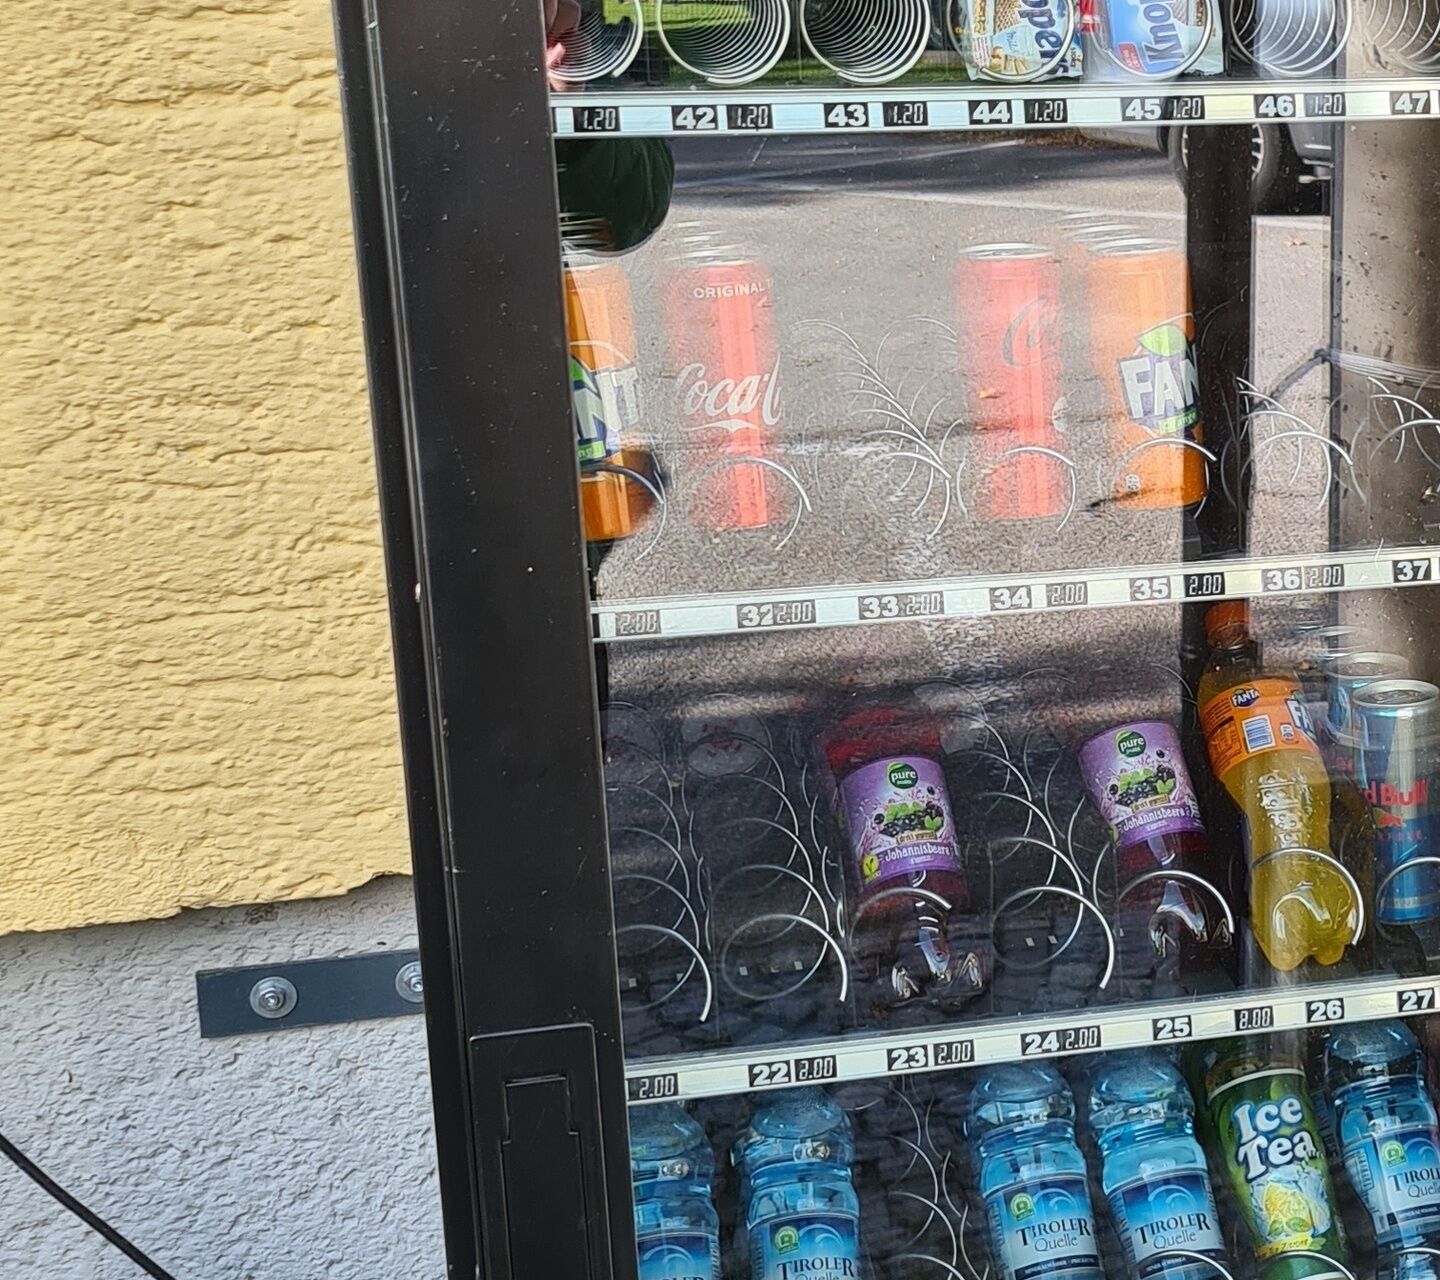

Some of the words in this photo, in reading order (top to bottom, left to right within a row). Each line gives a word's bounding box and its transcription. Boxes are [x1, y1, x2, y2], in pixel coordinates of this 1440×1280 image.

[828, 103, 867, 127] 43
[888, 103, 925, 126] 1.20
[972, 101, 1010, 123] 44
[1031, 100, 1065, 122] 1.20
[1125, 97, 1162, 120] 45
[1172, 96, 1202, 118] 1.20
[1259, 95, 1293, 117] 46
[1312, 95, 1344, 115] 1.20
[1395, 93, 1429, 114] 47
[582, 108, 617, 130] 1.20
[675, 107, 716, 130] 42
[734, 106, 768, 128] 1.20
[694, 281, 765, 299] ORIGINAL
[1121, 346, 1200, 419] FAN
[1267, 569, 1299, 590] 36
[1309, 566, 1341, 587] 2.00
[1397, 561, 1429, 580] 37
[994, 587, 1031, 608] 34
[1052, 584, 1086, 605] 2.00
[1133, 578, 1168, 598] 35
[1187, 574, 1222, 596] 2.00
[741, 606, 775, 628] 32
[862, 595, 900, 618] 33
[1232, 689, 1260, 707] FANTA
[1120, 737, 1145, 752] pure
[891, 772, 917, 784] pure
[1311, 1000, 1343, 1021] 26
[1402, 990, 1433, 1009] 27
[1156, 1018, 1190, 1039] 25
[1024, 1033, 1060, 1054] 24
[1065, 1027, 1098, 1050] 2.00
[890, 1048, 927, 1069] 23
[938, 1042, 972, 1064] 2.00
[752, 1064, 789, 1085] 22
[639, 1075, 676, 1098] 2.00
[1232, 1096, 1303, 1140] Ice
[1238, 1129, 1316, 1180] Tea
[1016, 1218, 1091, 1246] TIROLER
[1135, 1213, 1211, 1245] TIROLER
[1153, 1230, 1197, 1250] Quelle
[1034, 1234, 1079, 1252] Quelle
